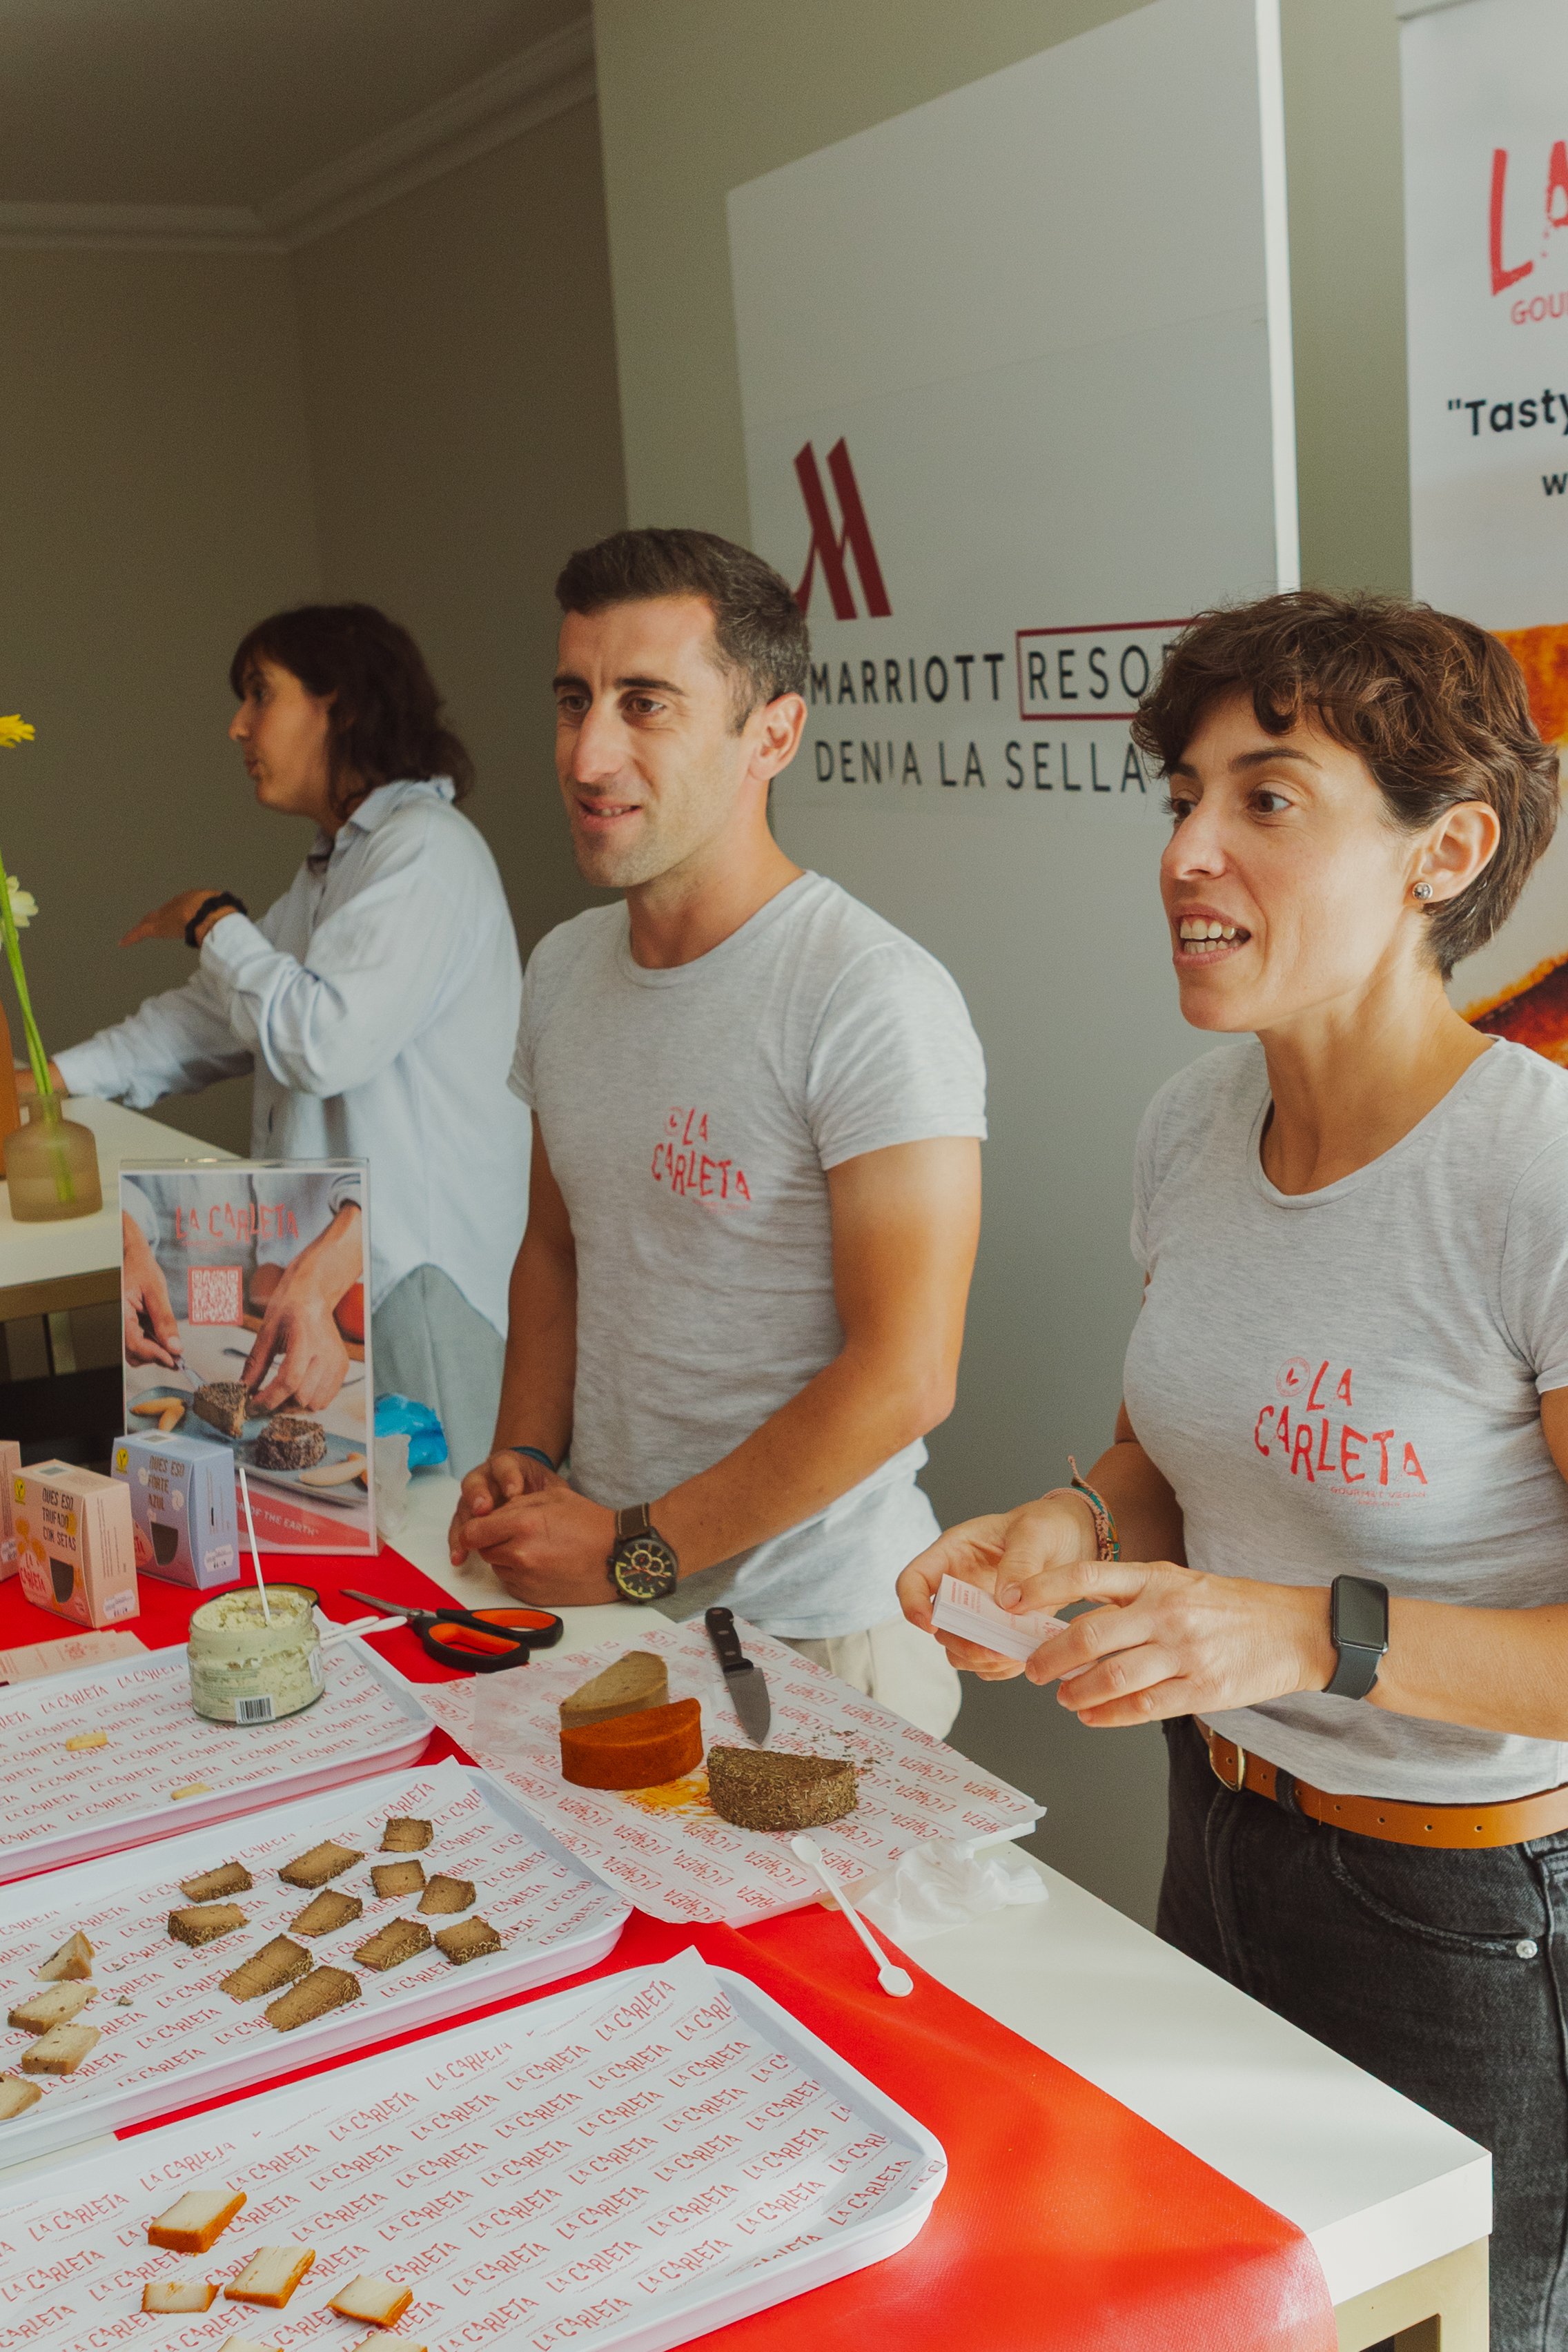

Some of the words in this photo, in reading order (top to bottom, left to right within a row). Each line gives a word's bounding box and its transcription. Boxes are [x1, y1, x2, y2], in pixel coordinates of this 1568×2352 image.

[1511, 290, 1568, 325] GOU
[810, 652, 1005, 705] MARRIOTT
[1028, 645, 1169, 700] RESO
[814, 739, 923, 786] DENIA
[938, 741, 986, 788] LA
[1004, 740, 1147, 794] SELLA
[682, 1107, 708, 1146] LA
[651, 1142, 752, 1201] CARLETA
[175, 1206, 200, 1239] LA
[208, 1202, 300, 1244] CARLETA
[1306, 1360, 1353, 1412] LA
[1254, 1404, 1429, 1486] CARLETA
[1331, 1486, 1383, 1499] GOURMET
[1388, 1491, 1426, 1499] VEGAN
[41, 1507, 70, 1529] TRUFADO
[57, 1531, 77, 1551] SETAS
[57, 1685, 108, 1708] CARLETA
[247, 1739, 300, 1759] CARLETA
[306, 1738, 357, 1758] CARLETA
[48, 1765, 101, 1786] CARLETA
[106, 1767, 160, 1785] CARLETA
[23, 1794, 79, 1816] CARLETA
[85, 1792, 141, 1814] CARLETA
[366, 1816, 384, 1829] LA
[382, 1783, 435, 1820] CARLETA
[423, 1848, 442, 1858] LA
[440, 1825, 494, 1851] CARLETA
[484, 1876, 502, 1888] LA
[492, 1884, 549, 1912] CARLETA
[538, 1934, 558, 1946] LA
[555, 1896, 609, 1934] CARLETA
[121, 1938, 181, 1964] CARLETA
[173, 1958, 193, 1970] LA
[192, 1934, 254, 1960] CARLETA
[83, 1999, 101, 2012] LA
[101, 1972, 166, 2001] CARLETA
[156, 1996, 177, 2009] LA
[176, 1969, 237, 1998] CARLETA
[596, 2024, 616, 2041] LA
[614, 1981, 675, 2028] CARLETA
[136, 2037, 158, 2050] LA
[157, 2008, 223, 2039] CARLETA
[426, 2072, 447, 2090] LA
[447, 2044, 512, 2077] CARLETA
[589, 2075, 609, 2090] LA
[607, 2045, 672, 2078] CARLETA
[669, 2075, 689, 2088] LA
[687, 2041, 750, 2077] CARLETA
[329, 2126, 351, 2142] LA
[351, 2093, 419, 2129] CARLETA
[411, 2126, 431, 2141] LA
[432, 2095, 499, 2129] CARLETA
[578, 2122, 599, 2136] LA
[598, 2092, 664, 2124] CARLETA
[663, 2119, 684, 2133] LA
[683, 2088, 747, 2121] CARLETA
[140, 2175, 162, 2191] LA
[164, 2144, 235, 2178] CARLETA
[310, 2177, 331, 2191] LA
[332, 2145, 402, 2179] CARLETA
[396, 2174, 418, 2188] LA
[418, 2143, 488, 2176] CARLETA
[654, 2167, 676, 2182] LA
[674, 2135, 741, 2169] CARLETA
[743, 2166, 764, 2179] LA
[763, 2128, 828, 2168] CARLETA
[556, 2223, 580, 2240] LA
[578, 2187, 649, 2225] CARLETA
[737, 2218, 758, 2235] LA
[757, 2182, 825, 2219] CARLETA
[828, 2211, 851, 2224] LA
[847, 2161, 911, 2209] CARLETA
[28, 2224, 51, 2242] LA
[53, 2194, 128, 2229] CARLETA
[378, 2225, 401, 2241] LA
[401, 2191, 473, 2227] CARLETA
[1, 2284, 25, 2302] LA
[27, 2251, 105, 2289] CARLETA
[452, 2278, 476, 2296] LA
[476, 2243, 550, 2280] CARLETA
[547, 2277, 569, 2293] LA
[568, 2242, 642, 2280] CARLETA
[638, 2277, 660, 2292] LA
[660, 2240, 732, 2279] CARLETA
[532, 2333, 559, 2352] LA
[555, 2298, 634, 2337] CARLETA
